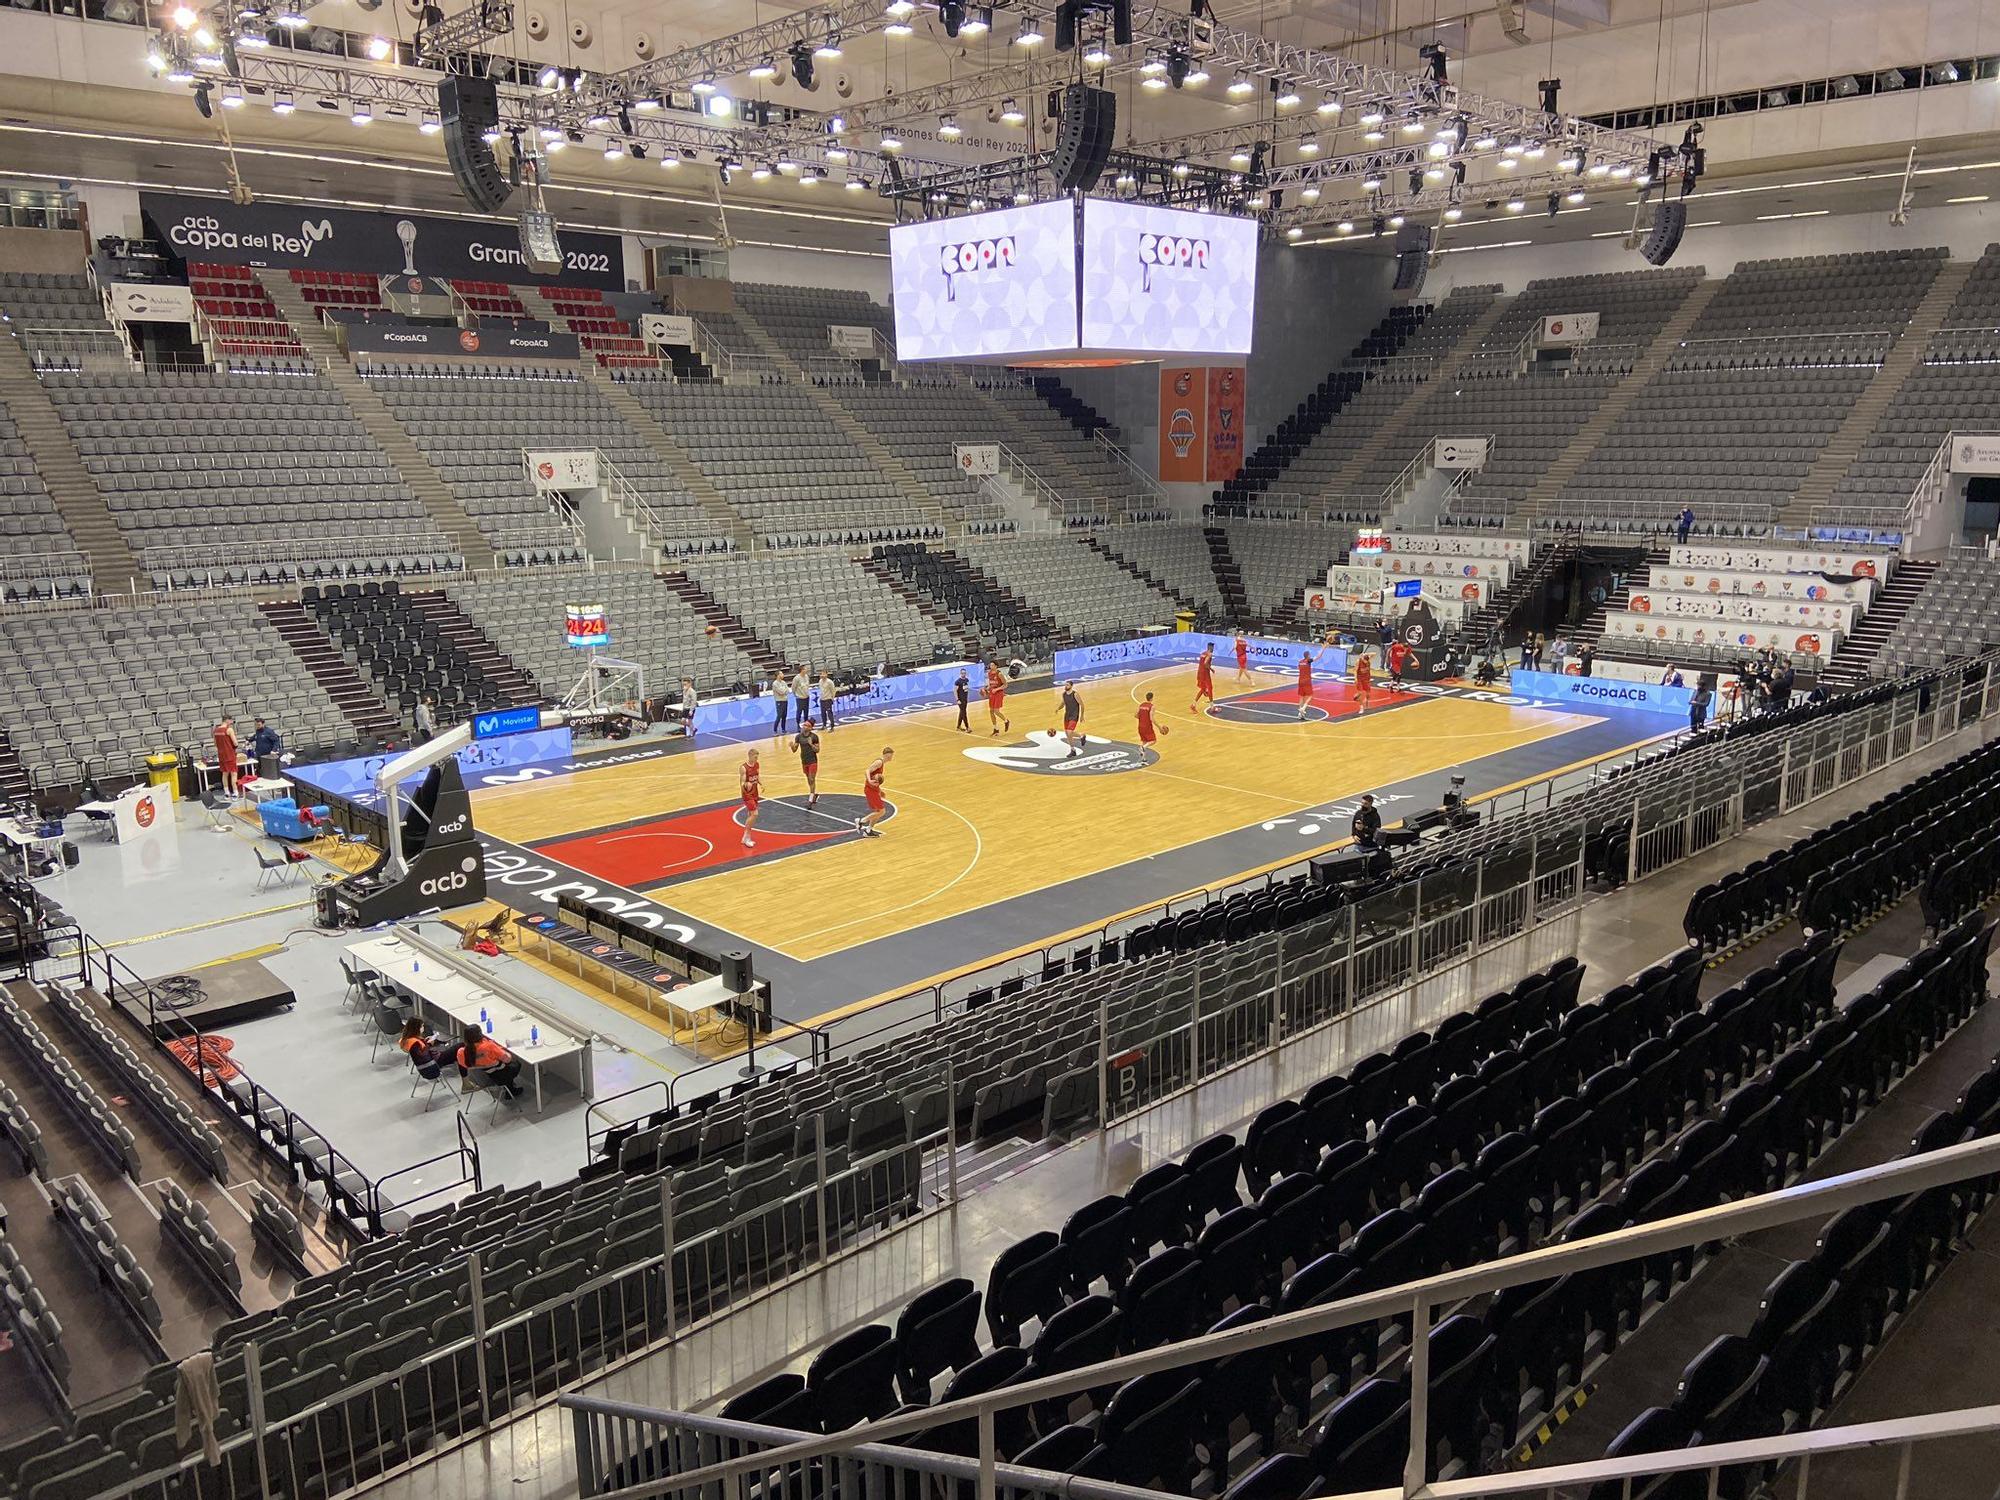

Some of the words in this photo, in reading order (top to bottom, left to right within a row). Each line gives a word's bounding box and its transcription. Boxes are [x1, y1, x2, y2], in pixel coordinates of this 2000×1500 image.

[967, 134, 983, 146] del
[987, 136, 1003, 151] Rey
[1007, 140, 1028, 153] 2022
[183, 216, 219, 231] acb
[170, 225, 238, 250] Copa
[242, 234, 268, 248] del
[272, 233, 314, 257] Rey
[567, 251, 609, 272] 2022
[384, 333, 428, 343] #CopaACB
[510, 338, 549, 348] #CopaACB
[568, 619, 580, 636] 24
[582, 619, 604, 636] 24
[1432, 660, 1448, 673] acb
[1460, 691, 1566, 708] Rey
[1572, 683, 1647, 701] #CopaACB
[503, 715, 534, 726] Movistar
[570, 714, 604, 727] endesa
[562, 749, 664, 770] Movistar
[439, 820, 462, 834] acb
[420, 871, 467, 896] acb
[1120, 1065, 1136, 1097] B
